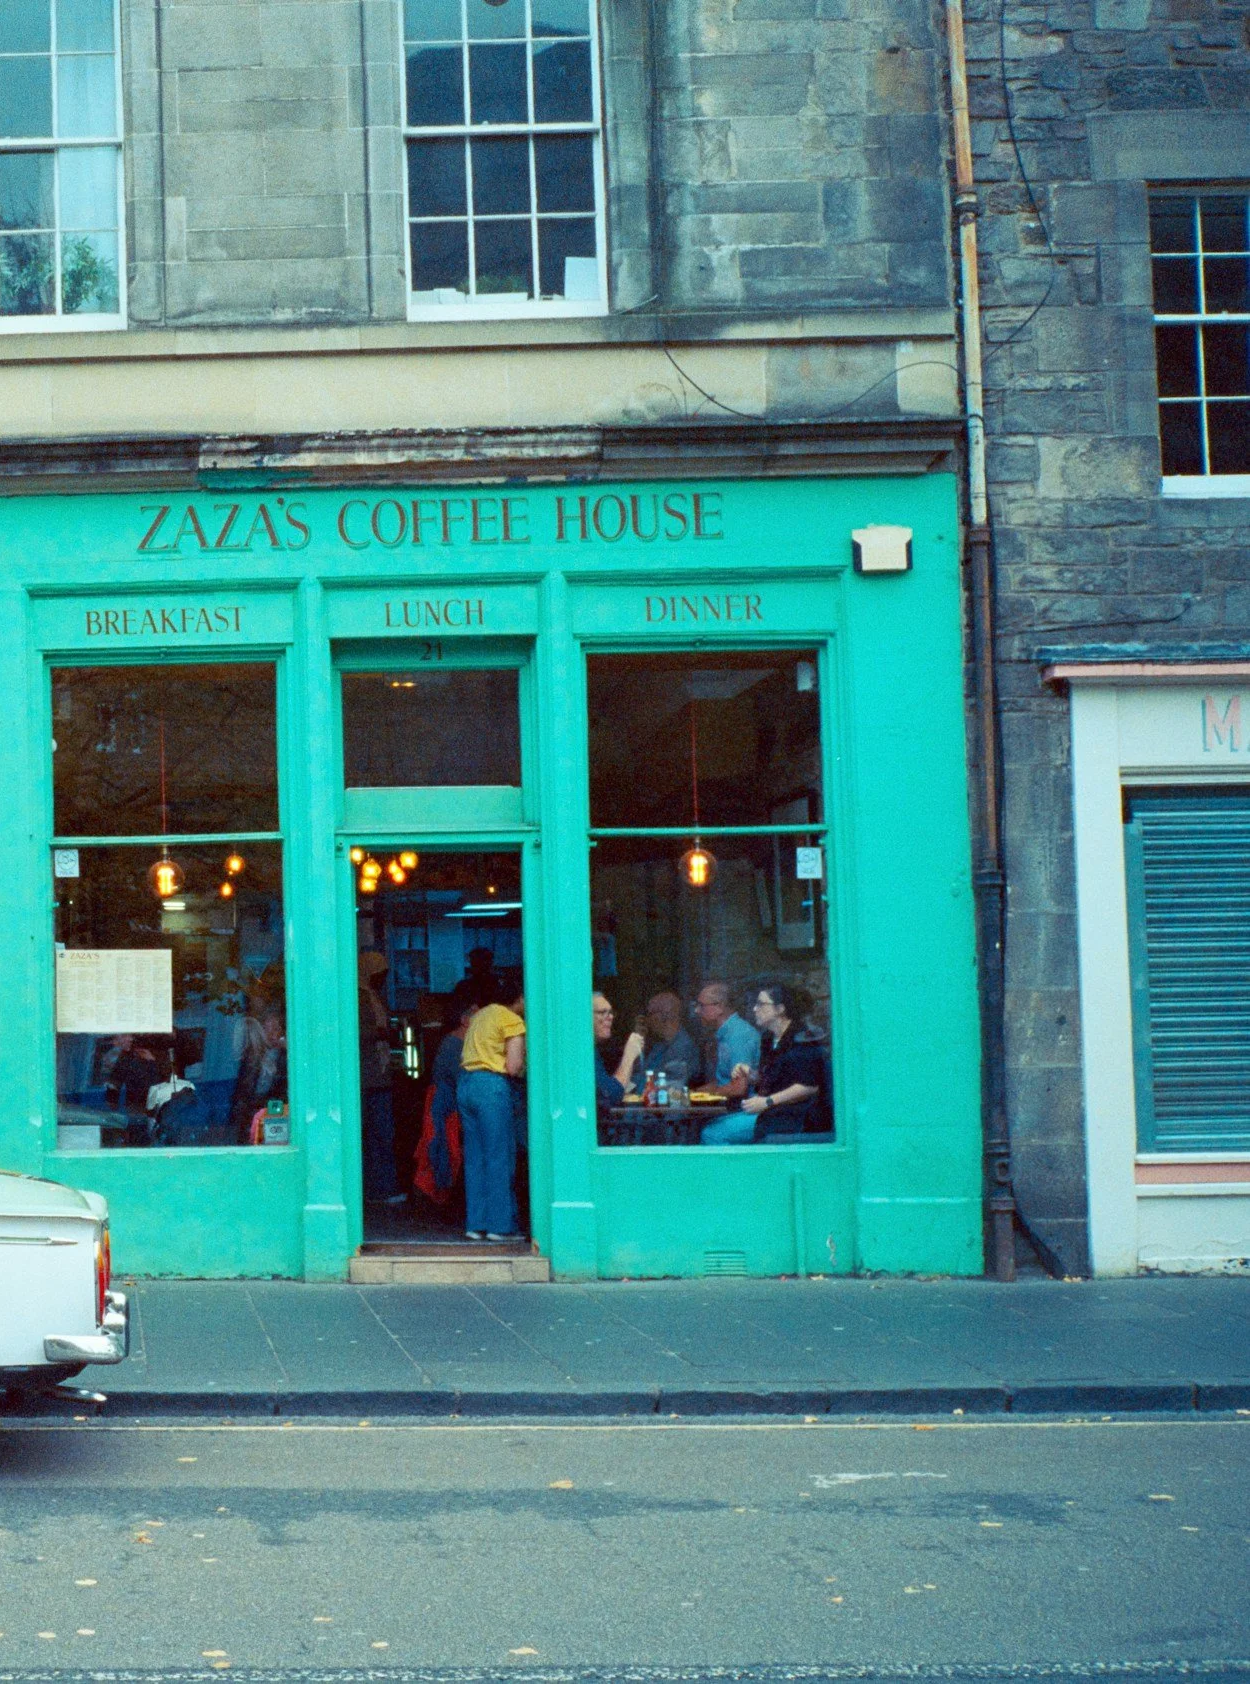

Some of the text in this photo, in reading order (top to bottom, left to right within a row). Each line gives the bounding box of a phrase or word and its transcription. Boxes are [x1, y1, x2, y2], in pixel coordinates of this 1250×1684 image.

[137, 492, 724, 553] ZAZA'S COFFEE HOUSE
[85, 606, 247, 636] BREAKFAST
[384, 599, 485, 628] LUNCH
[644, 594, 764, 622] DINNER
[419, 641, 443, 661] 21
[1201, 694, 1250, 753] M
